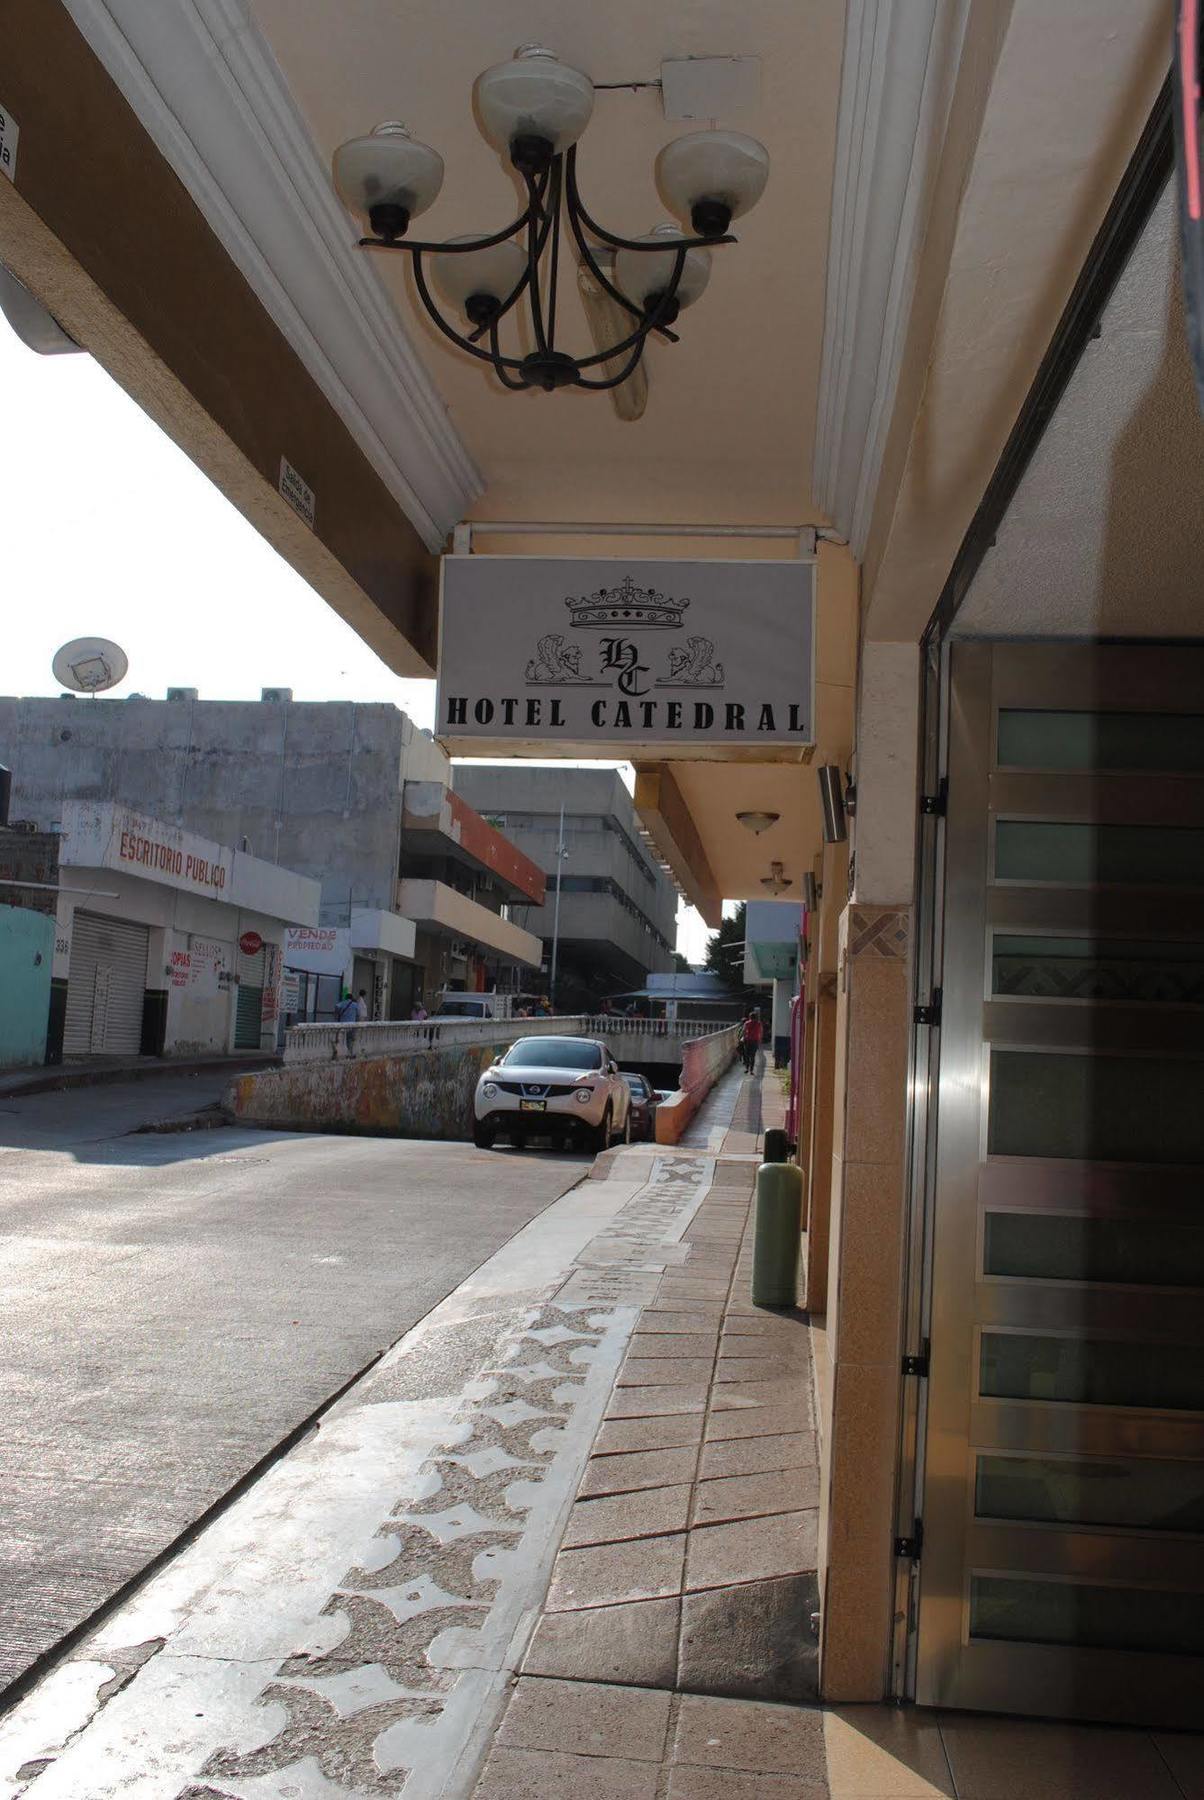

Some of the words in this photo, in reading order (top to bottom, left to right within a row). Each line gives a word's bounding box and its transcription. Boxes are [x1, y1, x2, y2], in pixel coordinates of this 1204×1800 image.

[447, 697, 565, 726] HOTEL
[591, 700, 804, 731] CATEDRAL
[119, 831, 183, 876] ESCRITORIO
[185, 854, 226, 889] PUBLICO
[288, 928, 337, 940] VENDE
